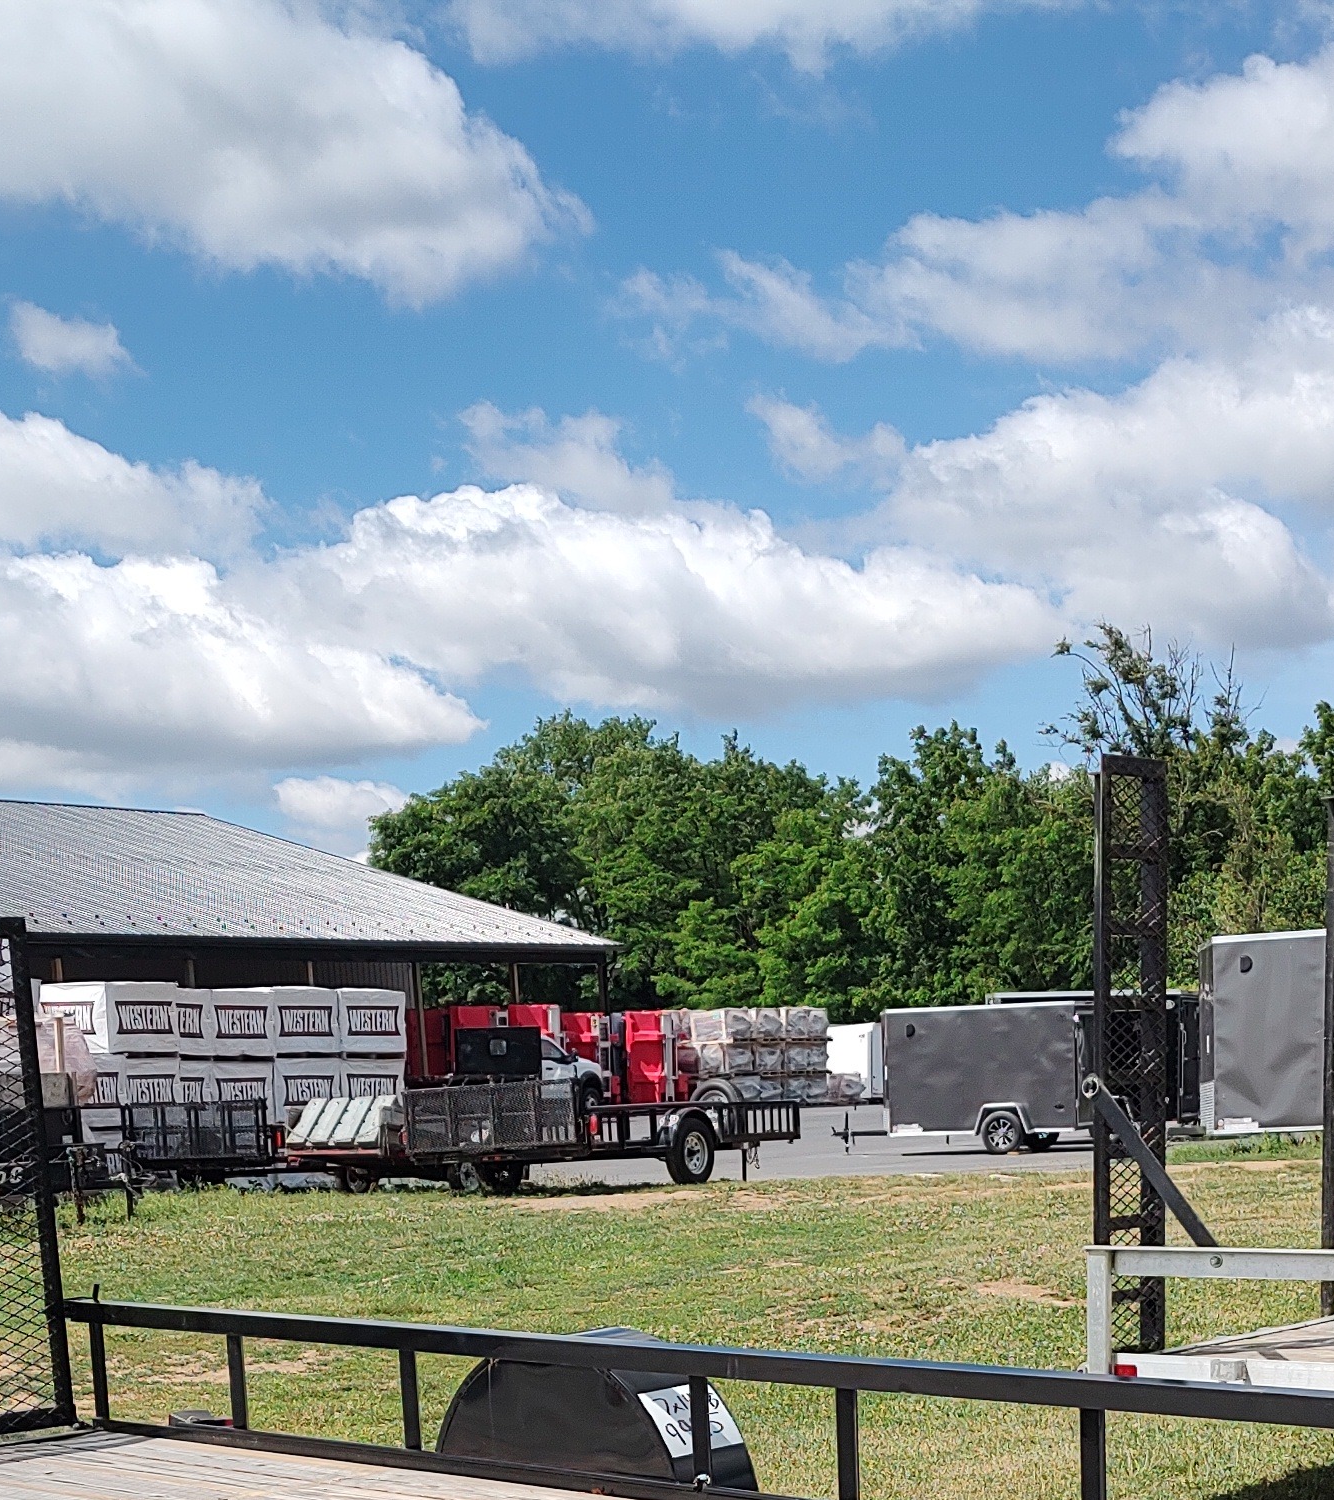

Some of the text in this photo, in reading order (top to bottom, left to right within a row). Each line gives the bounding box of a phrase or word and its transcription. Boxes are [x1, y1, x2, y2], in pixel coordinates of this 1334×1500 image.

[118, 1005, 171, 1030] WESTERN
[177, 1006, 201, 1034] TERN
[217, 1009, 265, 1035] WESTERN
[282, 1009, 329, 1033] WESTERN
[349, 1009, 396, 1032] WESTERN
[127, 1078, 173, 1104] WESTERN
[181, 1080, 202, 1104] TERN
[220, 1081, 264, 1101] WESTERN
[287, 1078, 331, 1102] WESTERN
[350, 1077, 395, 1101] WESTERN
